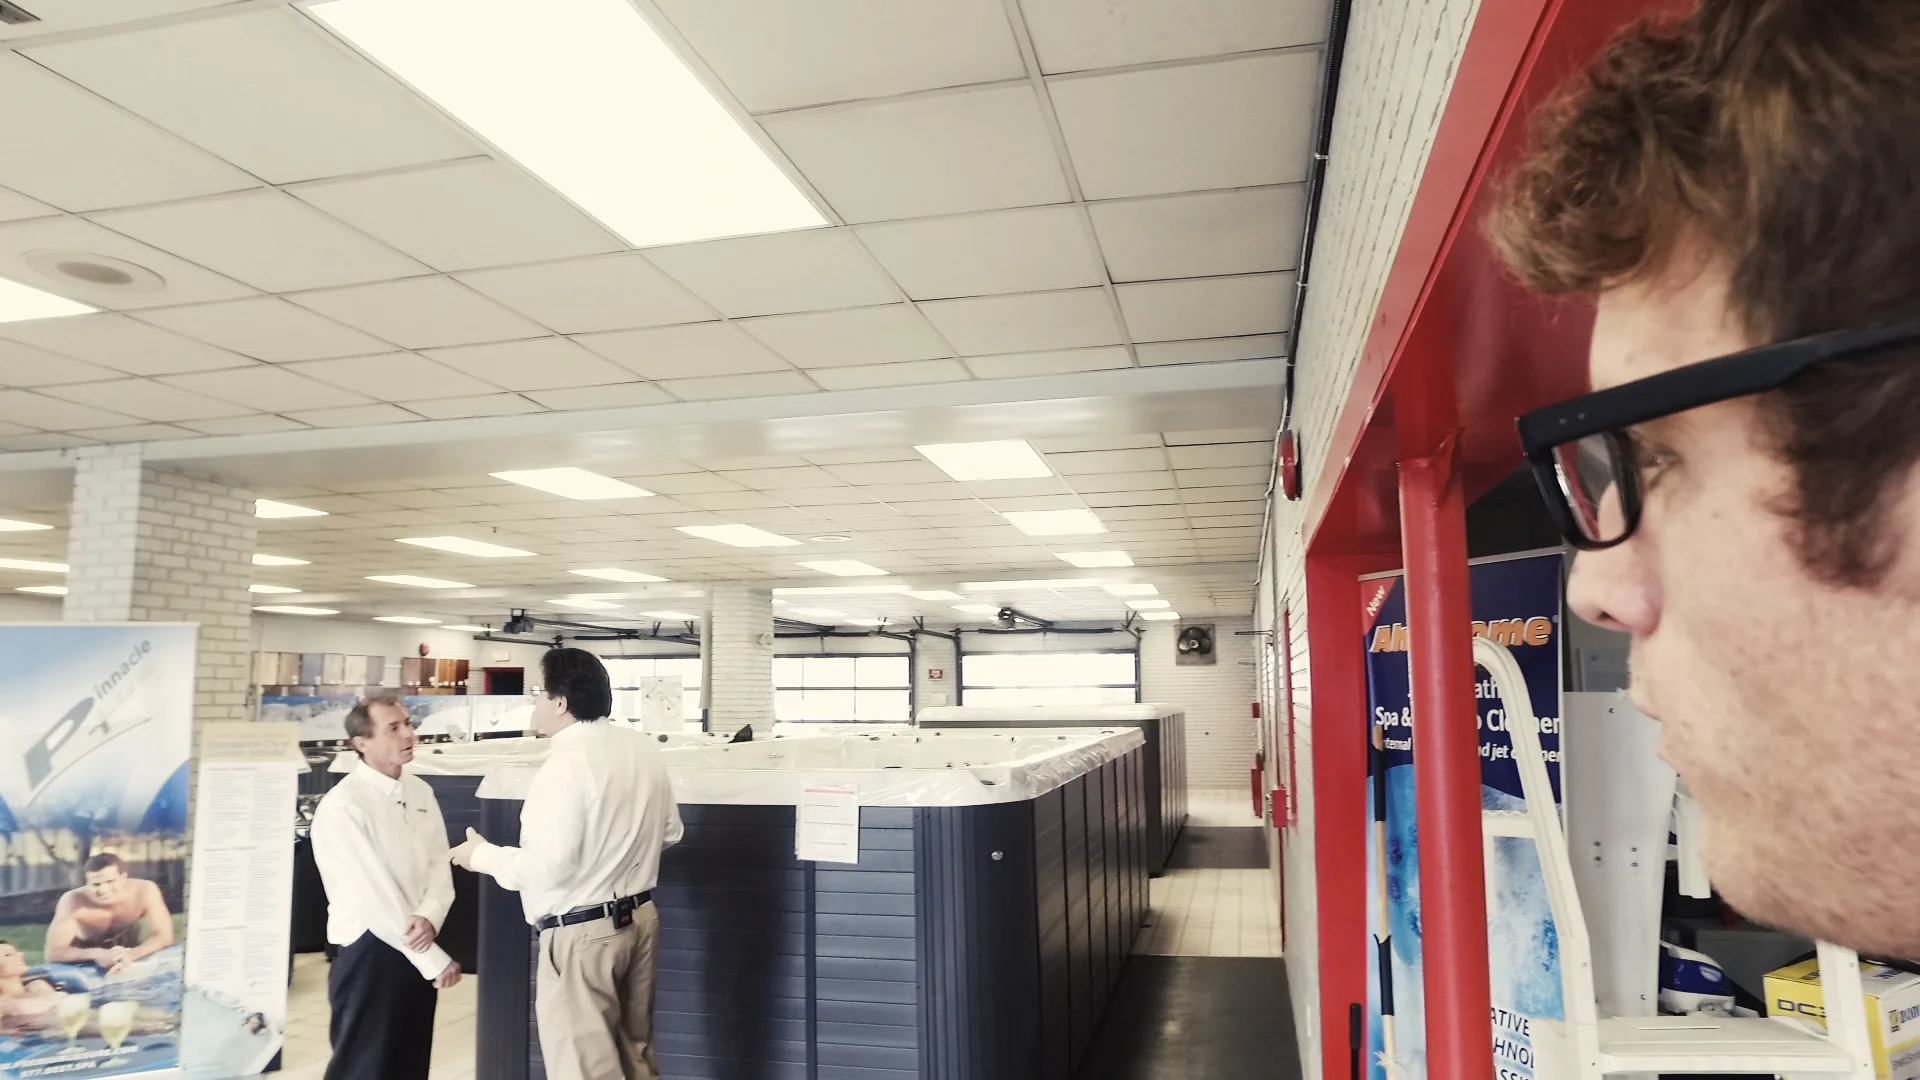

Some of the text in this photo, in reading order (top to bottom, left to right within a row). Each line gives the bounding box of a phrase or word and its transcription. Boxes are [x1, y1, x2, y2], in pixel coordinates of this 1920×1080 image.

[1375, 706, 1399, 731] Spa
[1400, 706, 1413, 727] &
[1490, 743, 1509, 761] jet
[1491, 1007, 1530, 1037] ATIVE
